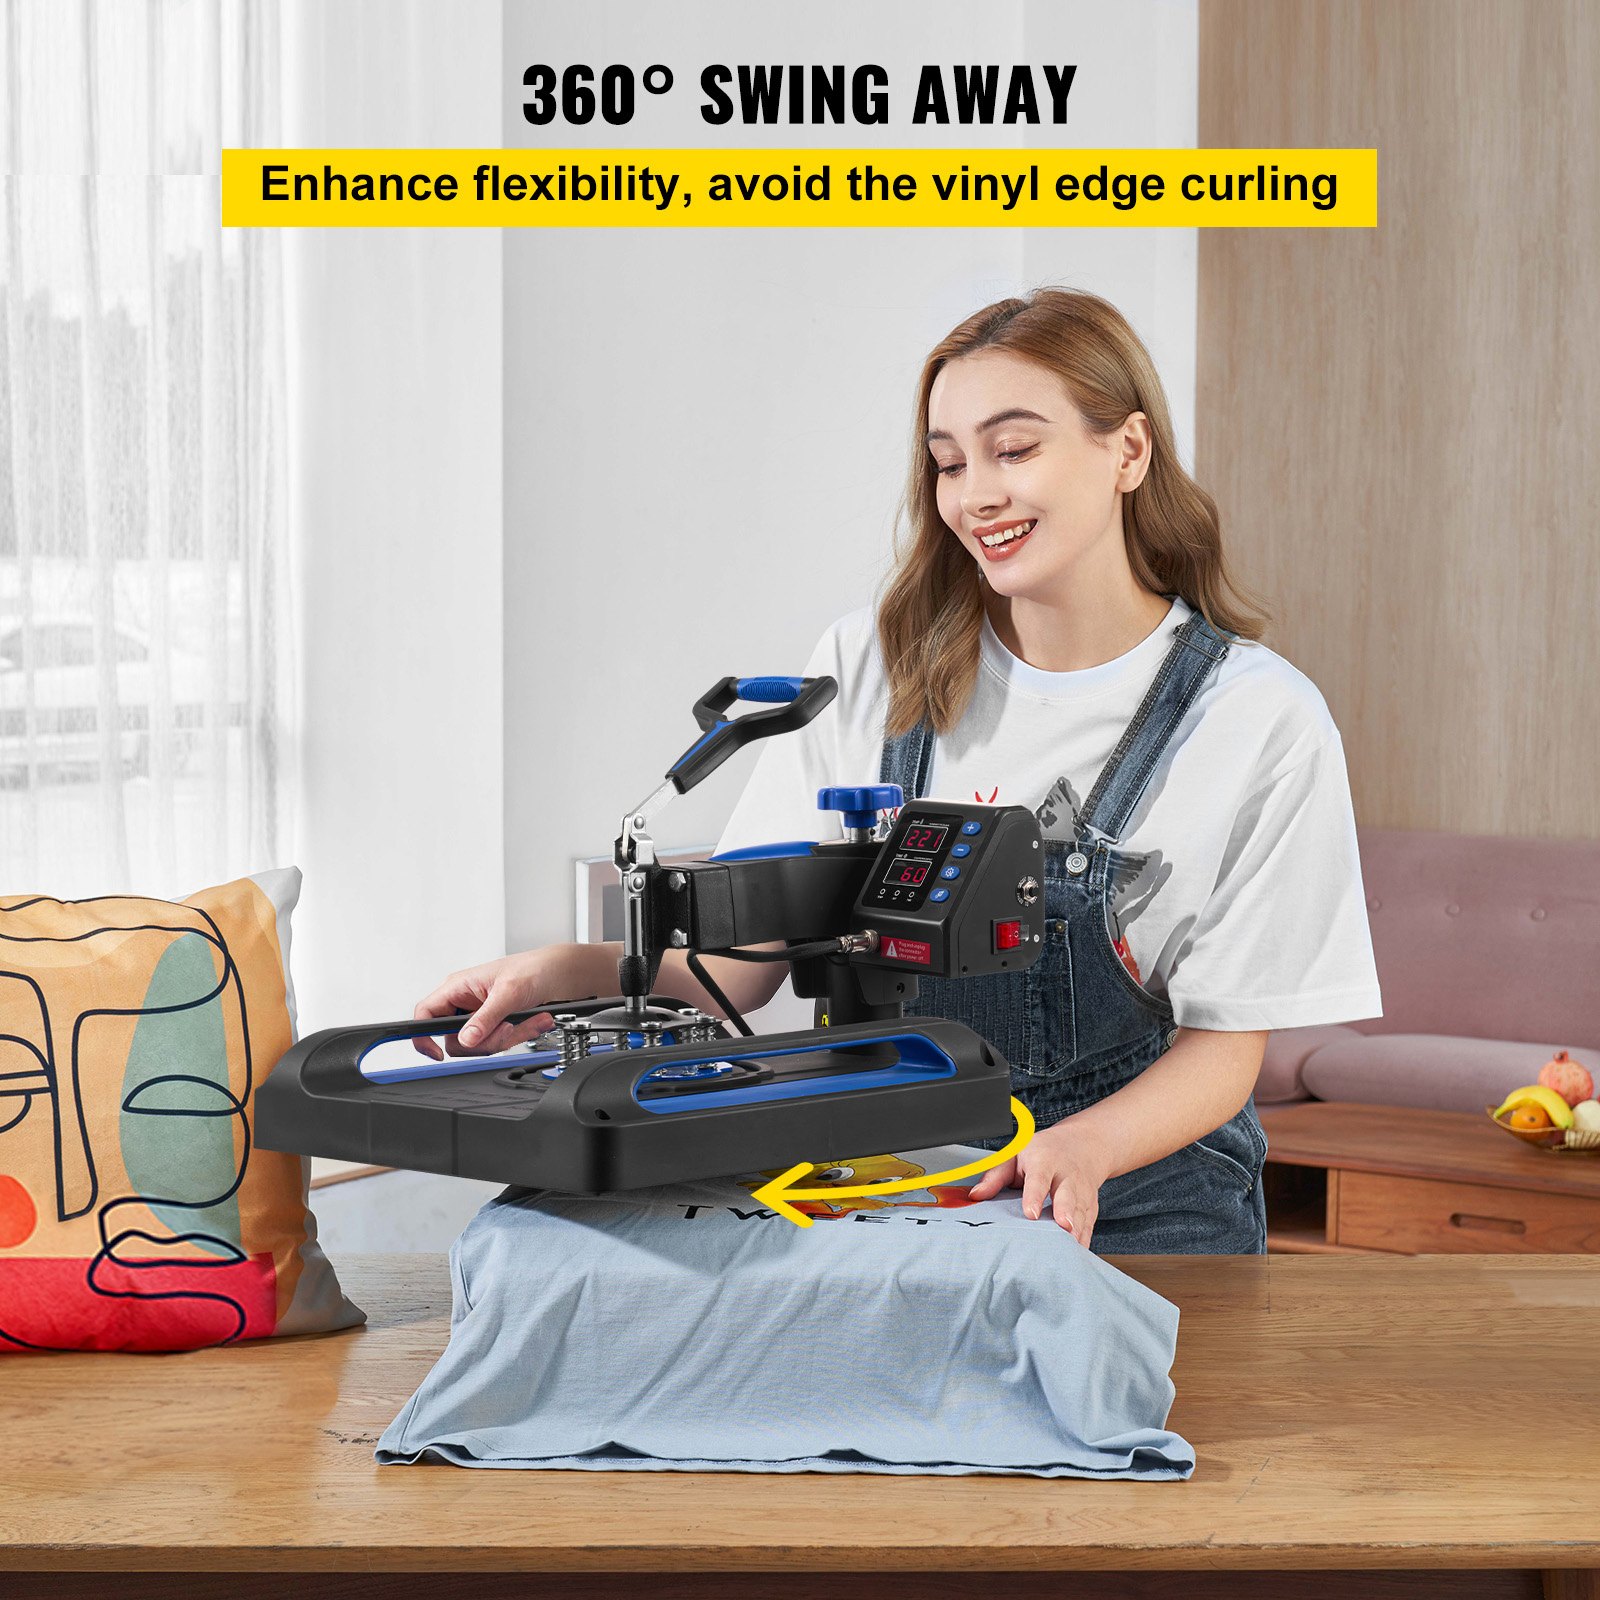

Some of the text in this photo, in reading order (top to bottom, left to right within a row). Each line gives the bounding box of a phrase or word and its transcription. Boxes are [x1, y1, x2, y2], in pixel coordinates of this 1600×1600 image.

[906, 829, 942, 848] 221
[900, 867, 927, 883] 60
[677, 1203, 996, 1227] TWEETY
